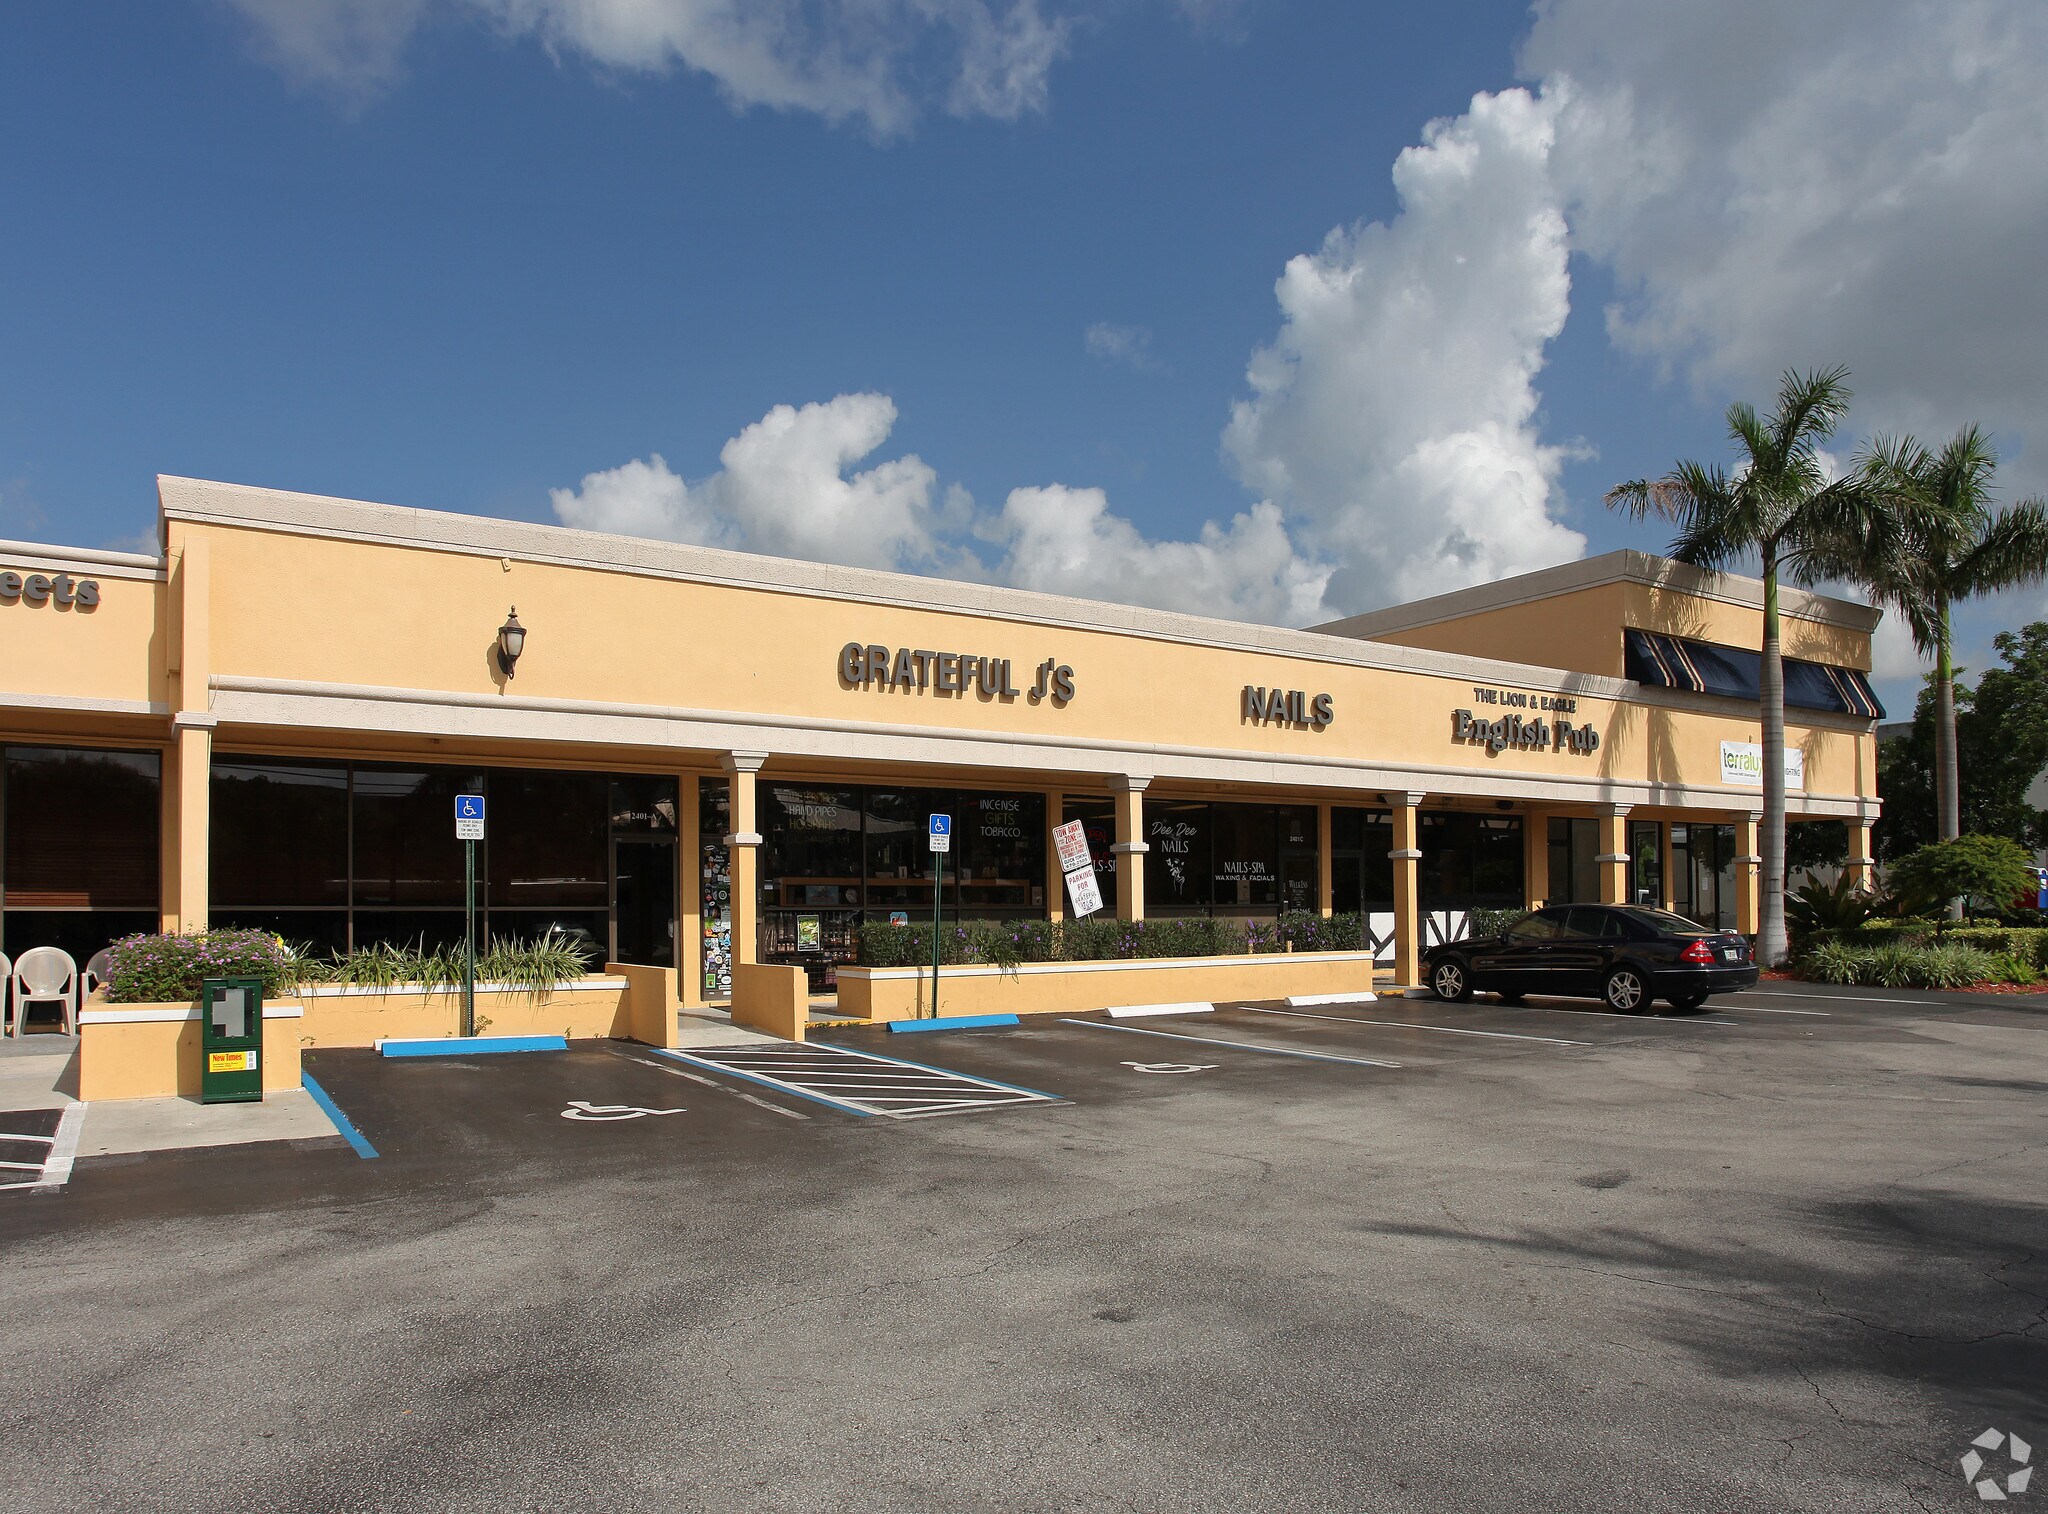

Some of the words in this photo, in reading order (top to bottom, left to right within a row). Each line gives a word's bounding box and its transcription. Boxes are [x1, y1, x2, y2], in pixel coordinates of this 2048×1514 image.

[0, 571, 100, 606] eets
[842, 641, 1021, 697] GRATEFUL
[1031, 657, 1076, 702] J'S
[1243, 684, 1334, 725] NAILS
[1473, 687, 1498, 705] THE
[1500, 690, 1527, 709] LION
[1530, 694, 1539, 710] &
[1541, 696, 1577, 714] EAGLE
[1454, 708, 1552, 752] English
[1556, 719, 1600, 751] Pub
[979, 799, 1020, 811] INCENSE
[985, 812, 1015, 825] GIFTS
[979, 826, 1021, 838] TOBACCO
[1055, 828, 1067, 839] TOW
[1067, 823, 1081, 835] AWAY
[1151, 821, 1174, 836] Dee
[1175, 822, 1198, 837] Dee
[1064, 832, 1077, 845] ZONE
[1161, 840, 1189, 854] NAILS
[1223, 861, 1266, 874] NAILS-SPA
[1068, 869, 1093, 885] PARKING
[1249, 874, 1276, 882] FACIALS
[1077, 880, 1089, 891] FOR
